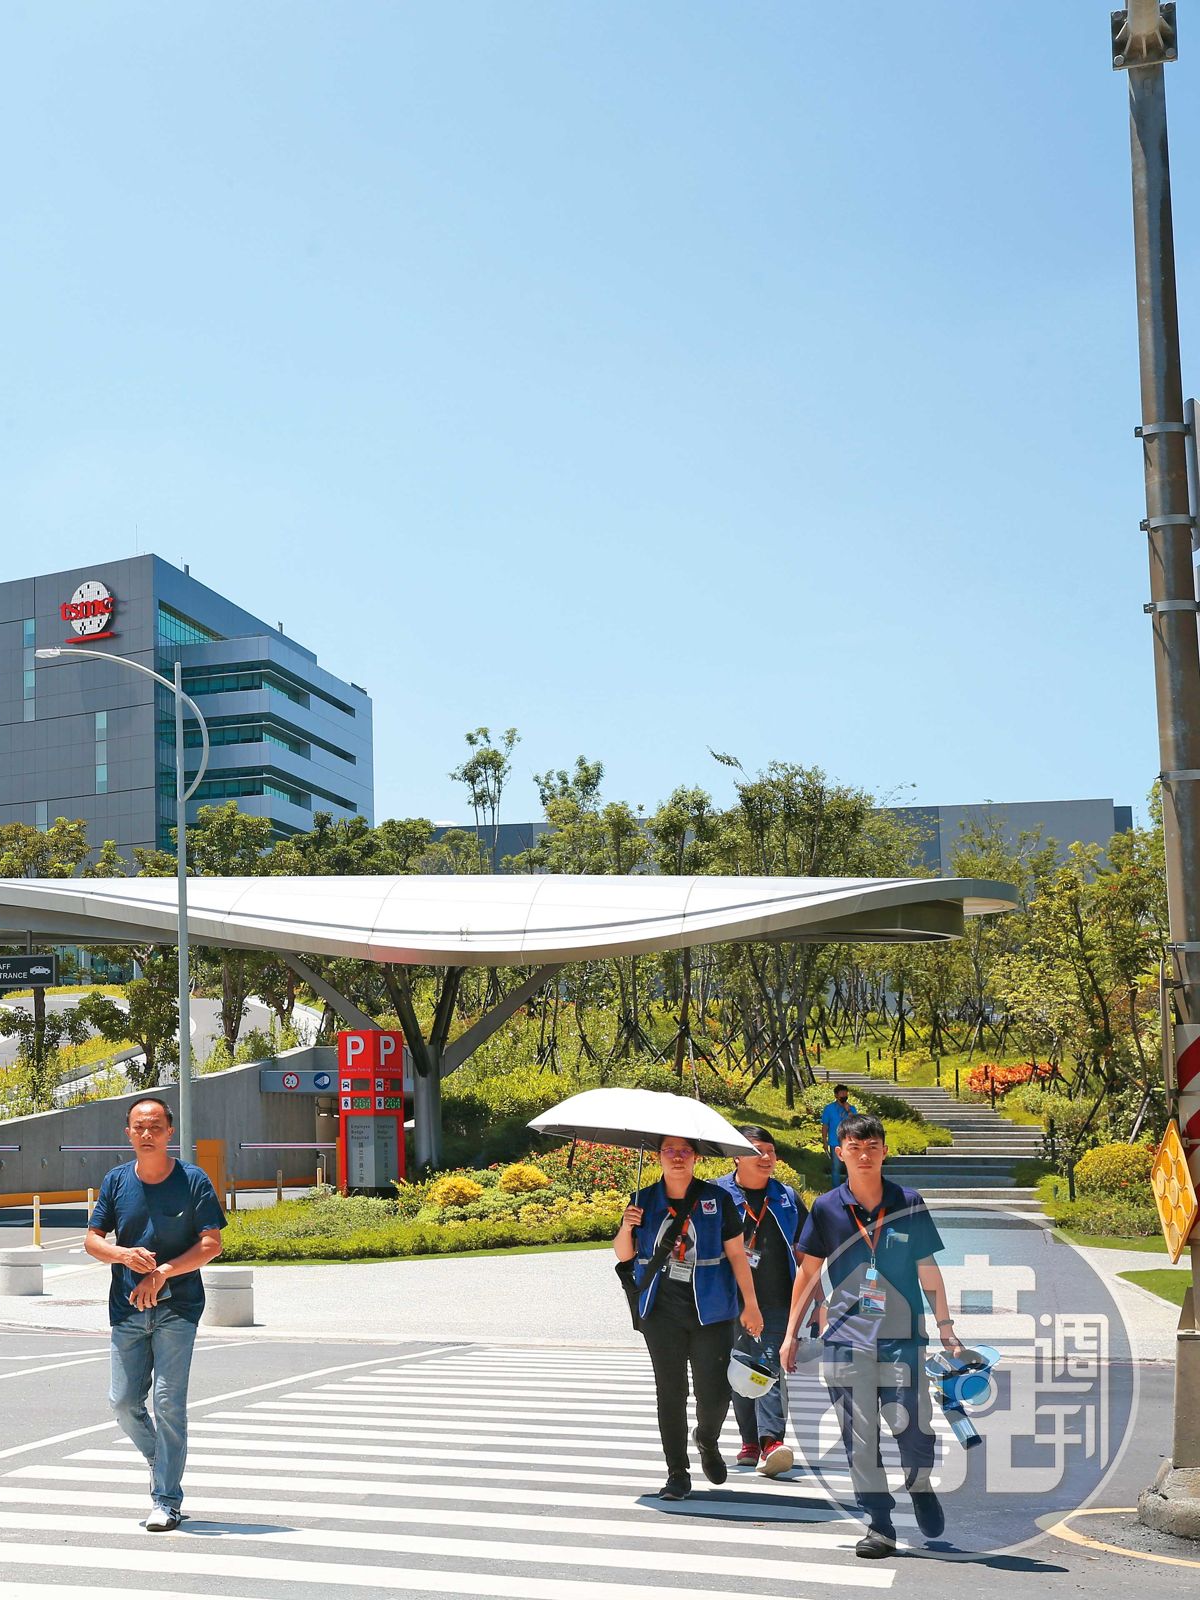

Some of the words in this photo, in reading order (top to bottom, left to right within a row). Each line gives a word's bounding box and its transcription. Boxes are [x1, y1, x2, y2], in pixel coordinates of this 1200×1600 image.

[60, 597, 113, 620] tsmc
[346, 1035, 365, 1066] P
[379, 1035, 396, 1066] P
